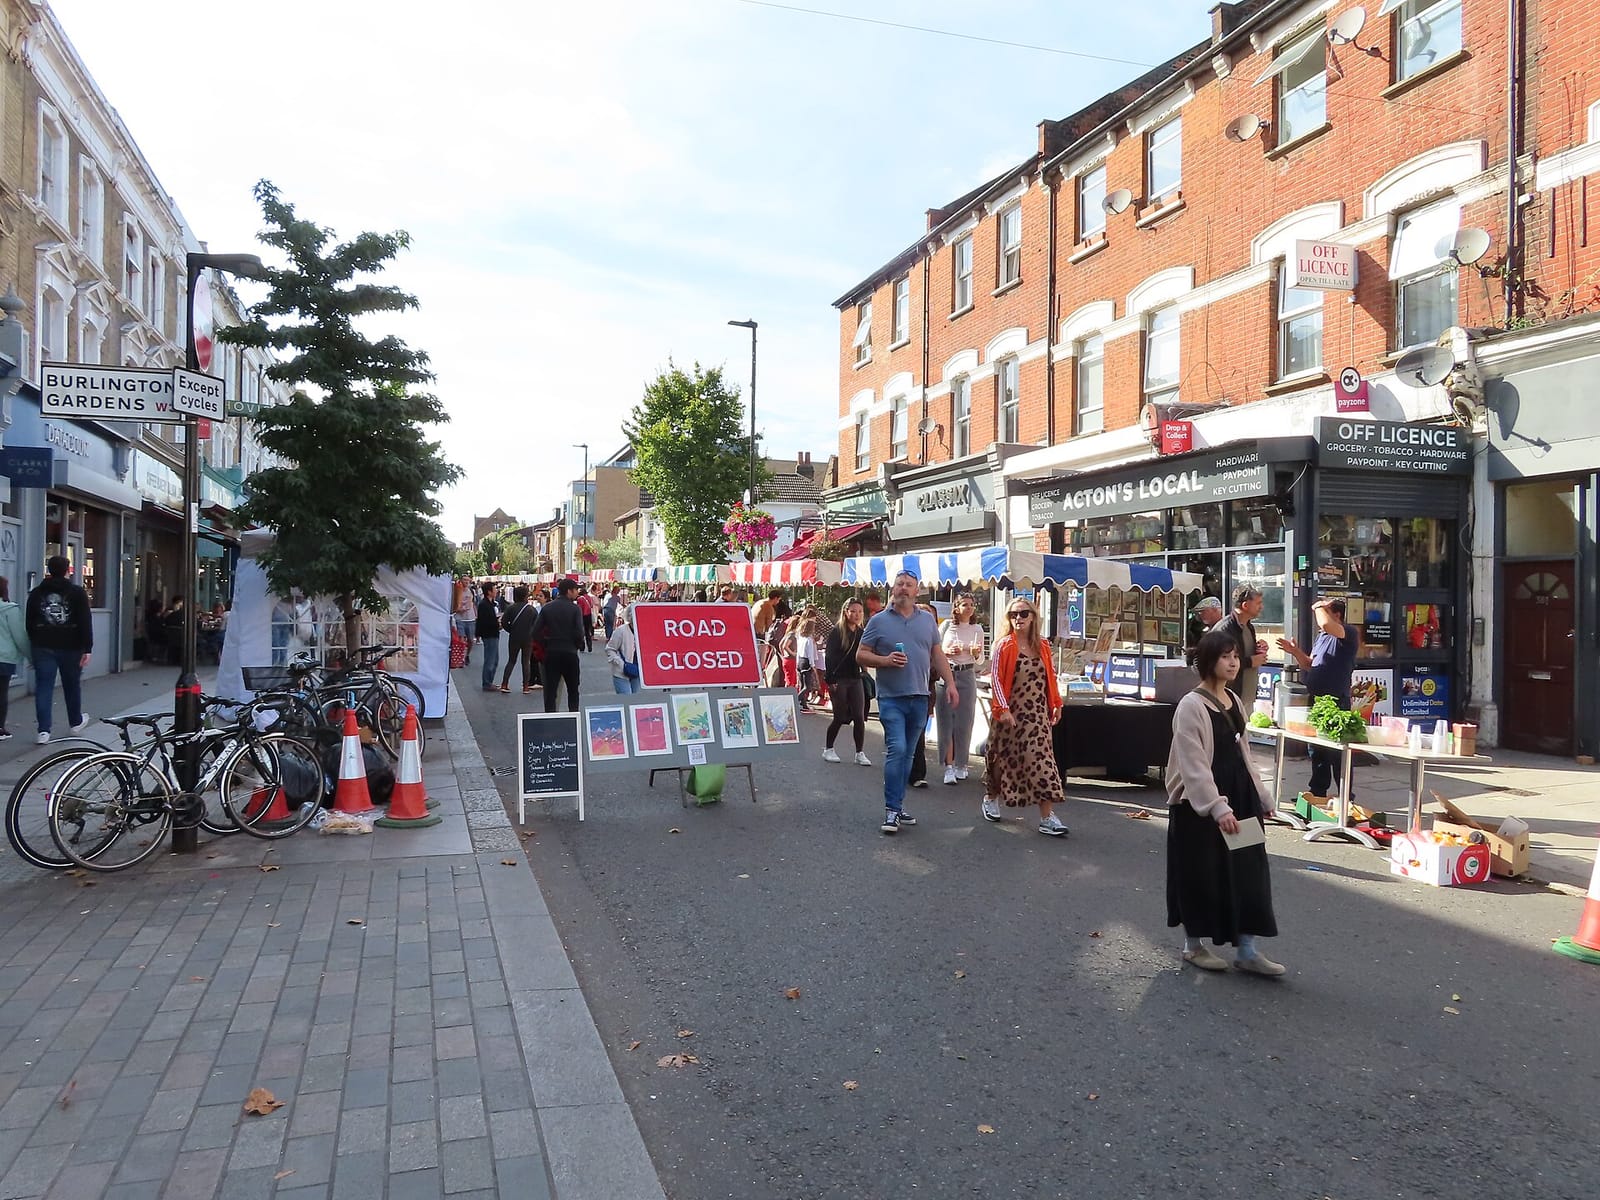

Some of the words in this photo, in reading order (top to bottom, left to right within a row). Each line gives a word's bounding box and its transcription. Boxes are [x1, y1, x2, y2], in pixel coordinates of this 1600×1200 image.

[1313, 245, 1339, 258] OFF
[1300, 259, 1349, 276] LICENCE
[47, 375, 174, 394] BURLINGTON
[179, 376, 219, 397] Except
[47, 394, 145, 411] GARDENS
[181, 395, 218, 412] cycles
[1338, 398, 1365, 408] payzone
[1165, 424, 1181, 432] Drop
[1339, 423, 1375, 441] OFF
[1381, 426, 1457, 447] LICENCE
[1327, 443, 1367, 453] GROCERY
[1374, 446, 1413, 456] TOBACCO
[1420, 449, 1467, 460] HARDWARE
[1216, 453, 1259, 468] HARDWARE
[1348, 458, 1388, 468] PAYPOINT
[1395, 460, 1411, 469] KEY
[1413, 462, 1448, 471] CUTTING
[1223, 467, 1261, 481] PAYPOINT
[1063, 482, 1134, 511] ACTON'S
[1139, 470, 1204, 500] LOCAL
[1212, 486, 1227, 496] KEY
[1229, 481, 1262, 494] CUTTING
[1031, 502, 1053, 510] GROCERY
[1031, 512, 1054, 521] TOBACCO
[664, 619, 726, 637] ROAD
[656, 651, 743, 670] CLOSED
[1112, 656, 1135, 666] Connect
[1112, 670, 1125, 679] your
[1402, 699, 1429, 707] Unlimited
